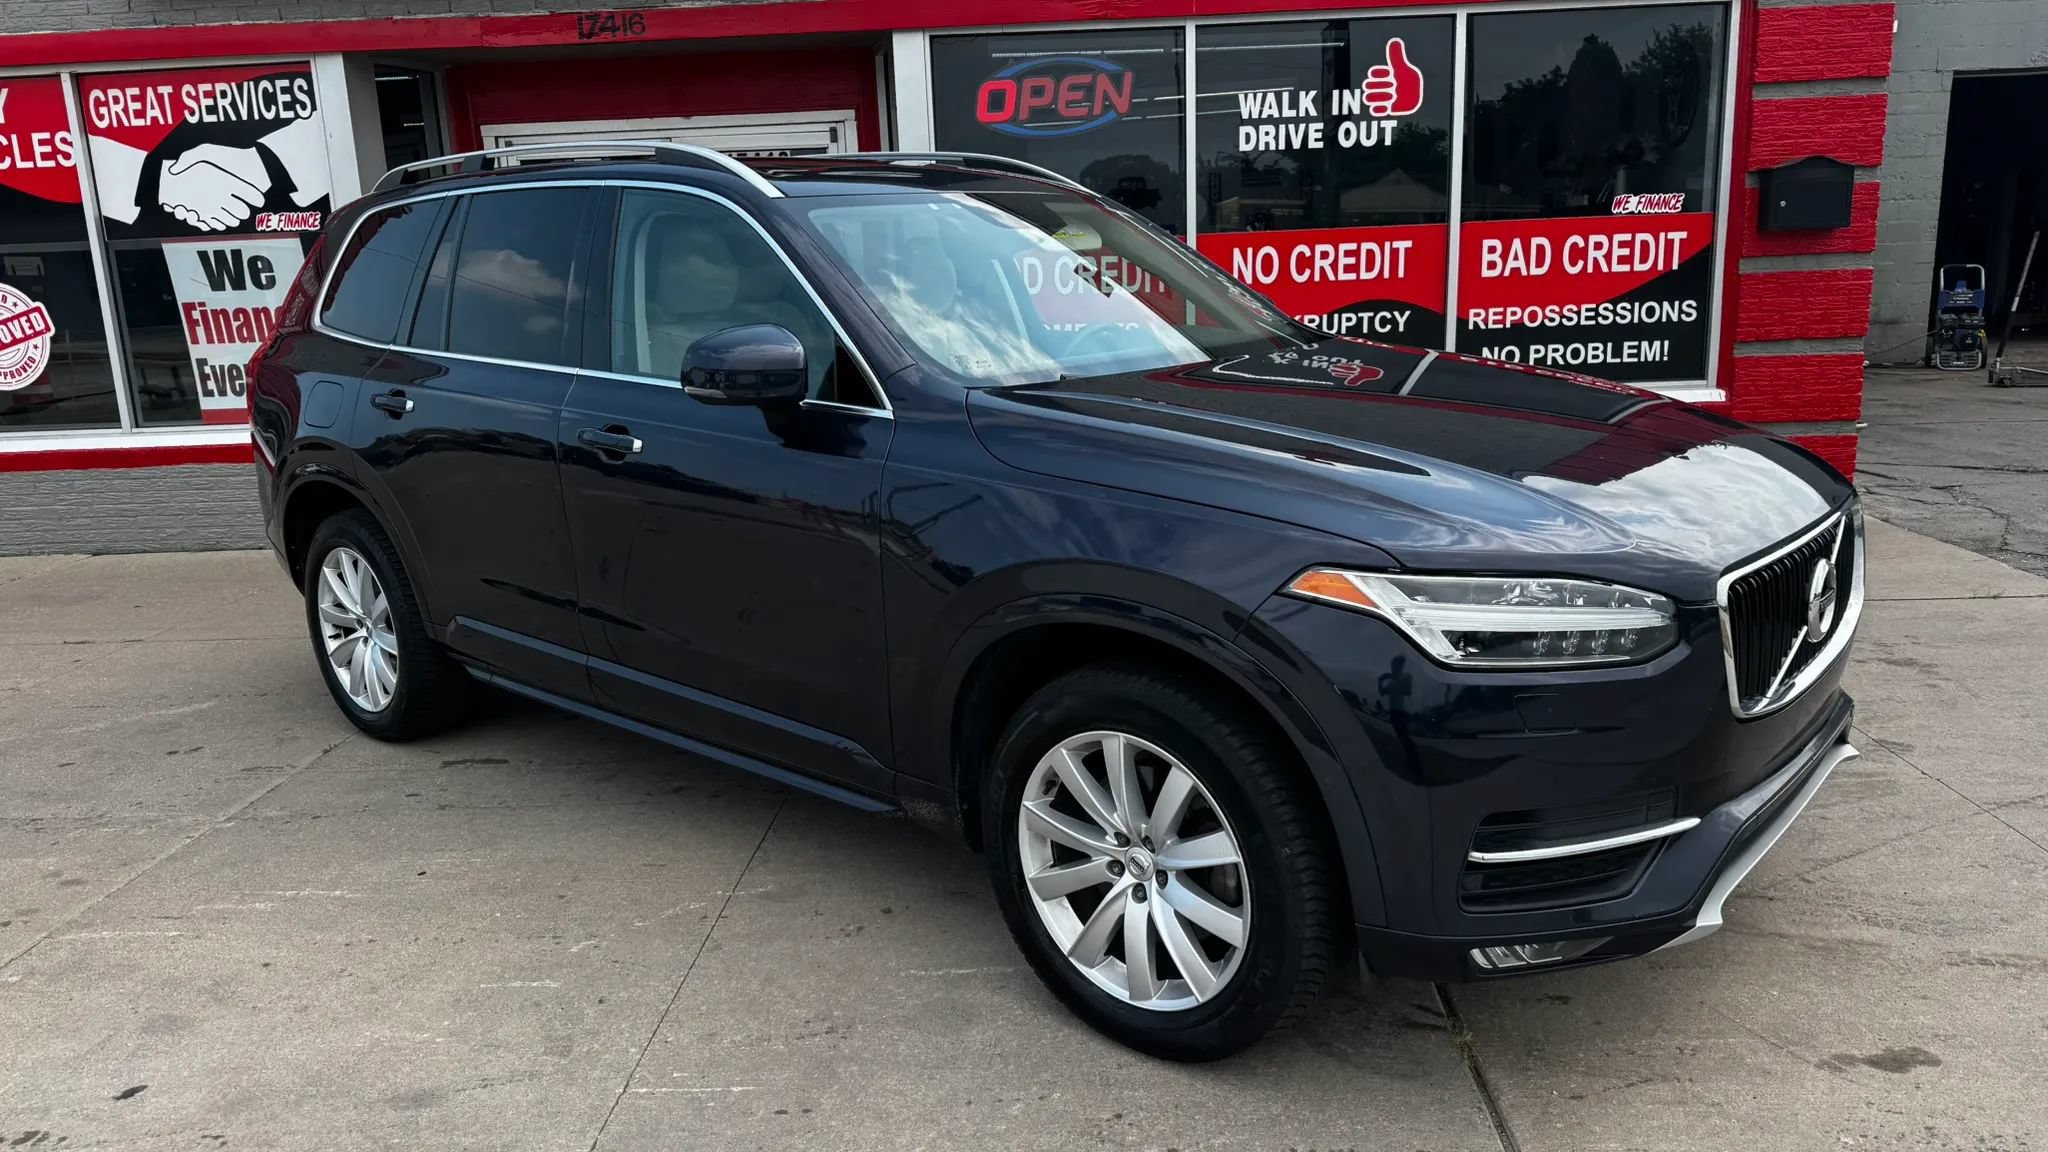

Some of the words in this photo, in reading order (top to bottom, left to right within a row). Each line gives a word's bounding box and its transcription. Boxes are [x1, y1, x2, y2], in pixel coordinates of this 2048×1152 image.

[577, 12, 646, 40] 17416
[88, 85, 174, 129] GREAT
[181, 78, 312, 124] SERVICES
[976, 71, 1133, 124] OPEN
[1238, 90, 1318, 119] WALK
[1332, 88, 1361, 115] IN
[1238, 122, 1324, 152] DRIVE
[1338, 119, 1398, 148] OUT
[1612, 194, 1632, 212] WE
[1635, 193, 1684, 212] FINANCE
[256, 213, 273, 230] WE
[277, 212, 320, 230] FINANCE
[1232, 245, 1279, 284] NO
[1289, 240, 1413, 282] CREDIT
[1481, 236, 1552, 278] BAD
[1562, 231, 1688, 275] CREDIT
[197, 249, 276, 292] We
[1293, 310, 1411, 335] RUPTCY
[1468, 300, 1698, 330] REPOSSESSIONS
[0, 355, 37, 380] PROVED
[1481, 345, 1520, 364] NO
[1529, 340, 1670, 366] PROBLEM!
[195, 358, 248, 398] Eve
